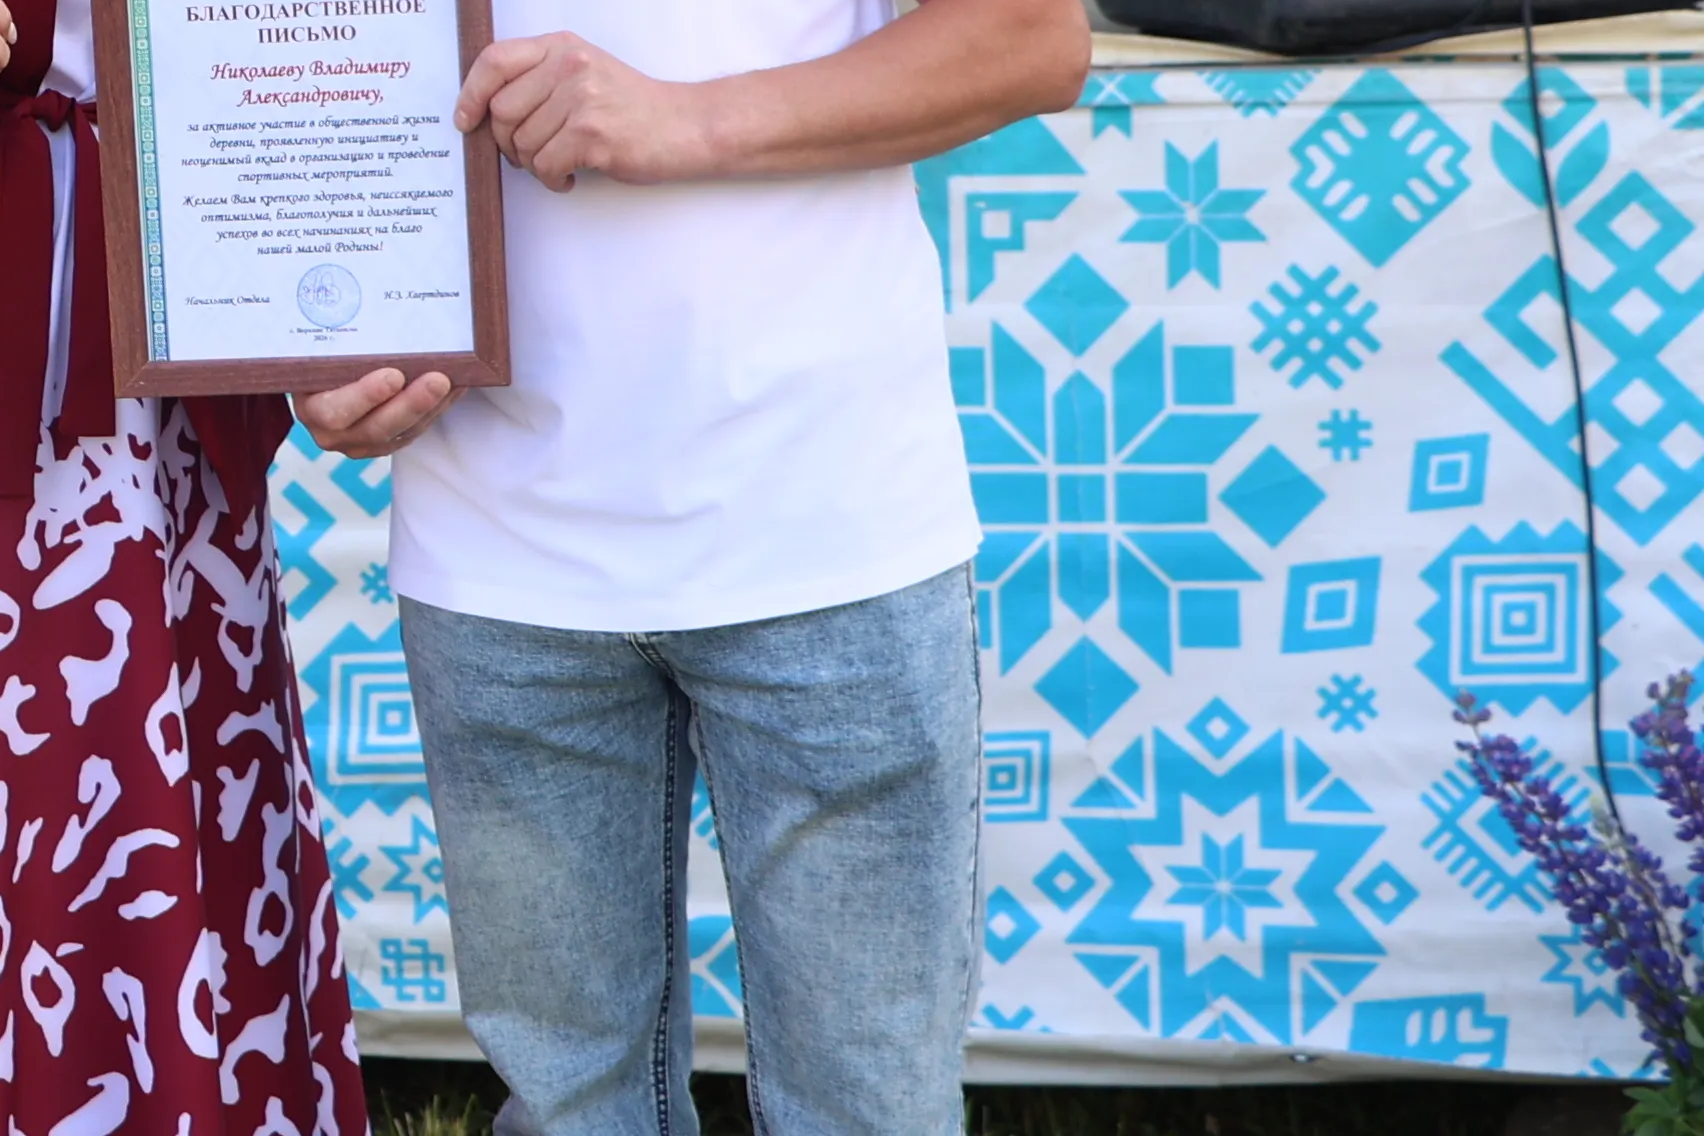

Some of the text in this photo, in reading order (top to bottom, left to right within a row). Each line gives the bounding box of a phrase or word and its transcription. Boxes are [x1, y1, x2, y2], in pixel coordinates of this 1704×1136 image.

[258, 25, 356, 43] ПИСЬМО
[211, 57, 410, 82] Николаеву Владимиру
[236, 85, 383, 107] Александровичу,
[187, 115, 440, 133] за активное участие в общественной жизни
[210, 133, 418, 151] деревни, проявленную инициативу и
[181, 147, 450, 168] неоценимый вклад в организацию и проведение
[238, 167, 393, 184] спортивных мероприятий.
[183, 190, 453, 207] Желаем Вам крепкого здоровья, неиссякаемого
[201, 205, 437, 222] оптимизма, благополучия и дальнейших
[216, 222, 422, 242] успехов во всех начинаниях на благо
[258, 241, 383, 255] нашей малой Родины!
[185, 295, 270, 306] Начальник Отдела
